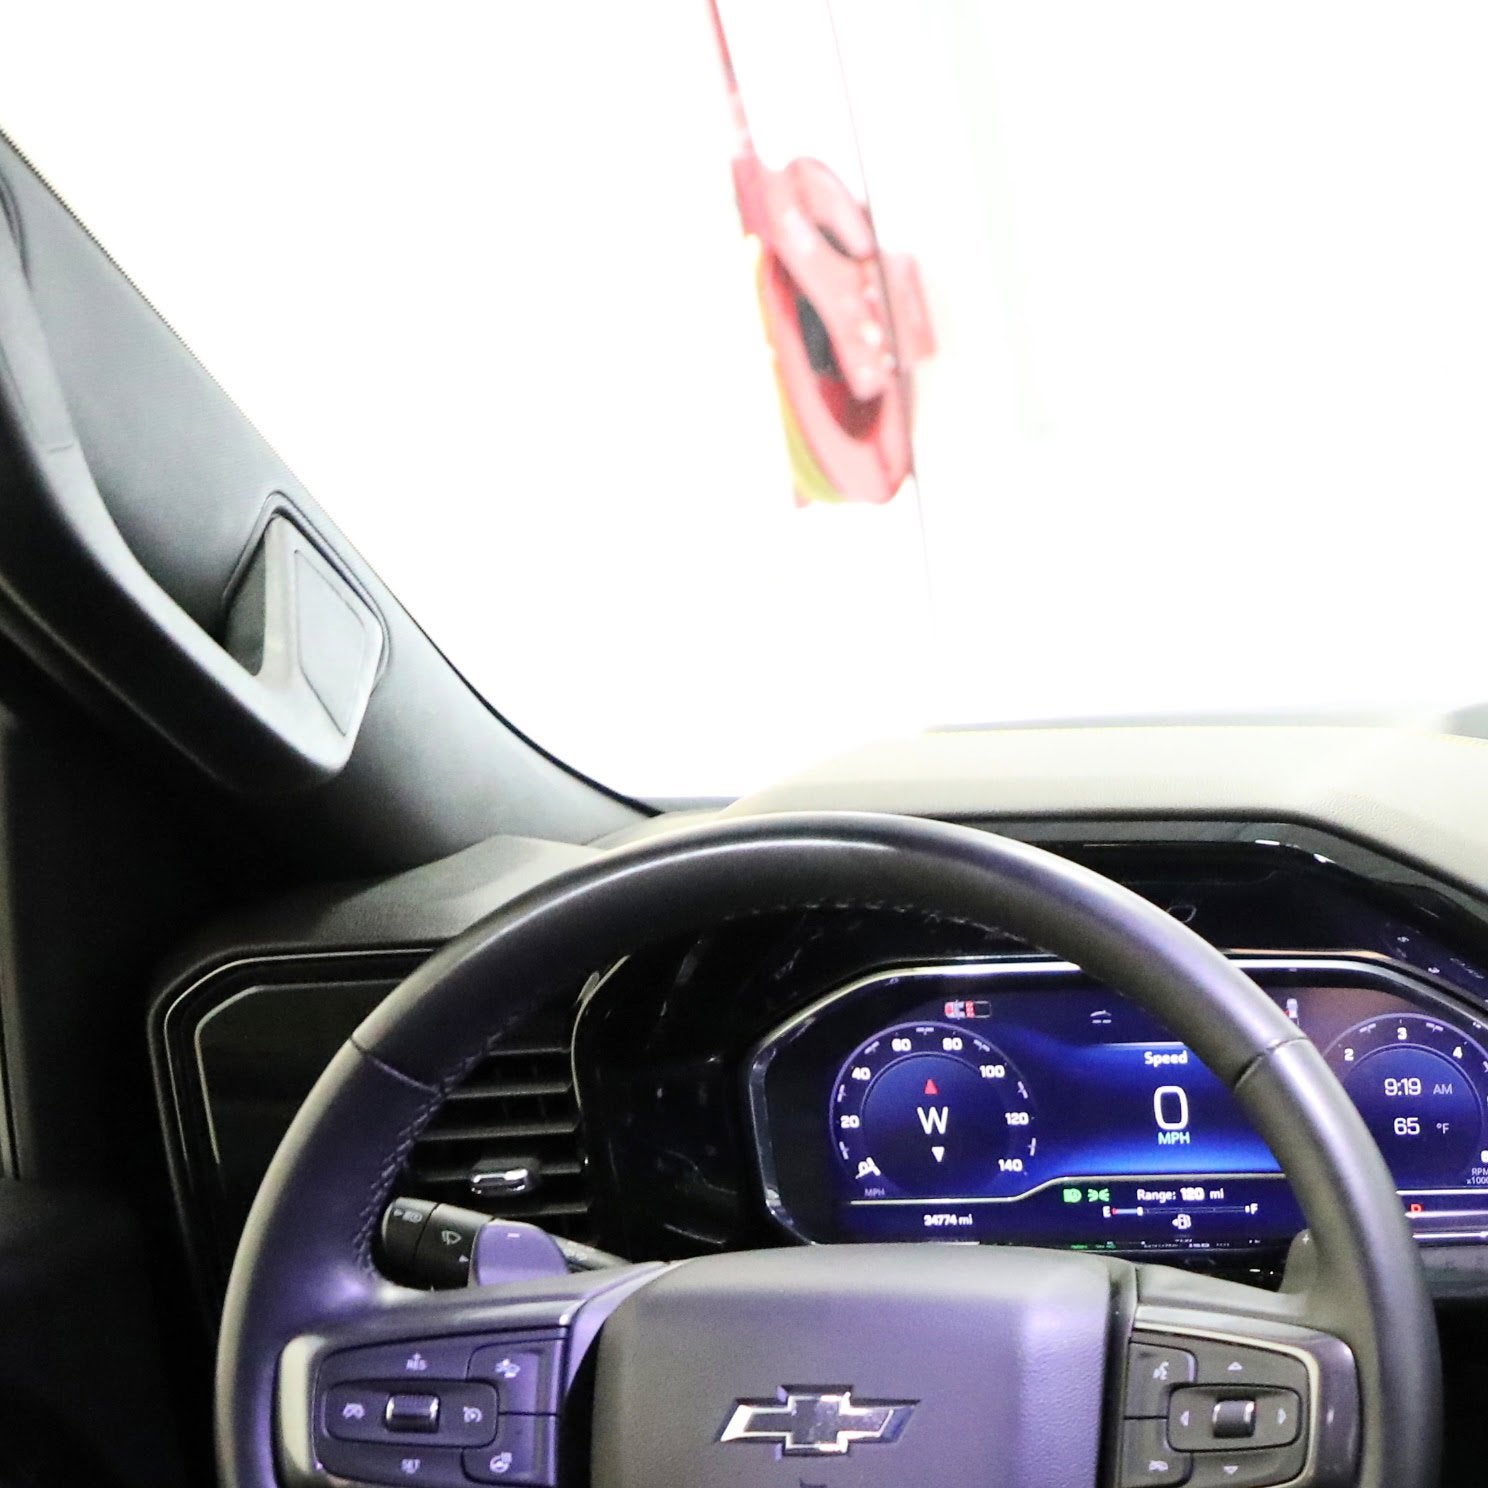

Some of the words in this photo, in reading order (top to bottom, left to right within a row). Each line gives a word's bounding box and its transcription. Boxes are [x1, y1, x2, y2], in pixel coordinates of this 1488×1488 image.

[1397, 1027, 1408, 1040] 3
[892, 1038, 912, 1051] 60
[942, 1038, 963, 1051] 80
[1144, 1051, 1188, 1067] Speed
[1344, 1048, 1354, 1061] 2
[1452, 1046, 1463, 1059] 4
[852, 1067, 871, 1080] 40
[979, 1065, 1005, 1078] 100
[1384, 1078, 1422, 1096] 9:19
[1433, 1083, 1453, 1095] AM
[1153, 1085, 1189, 1130] 0
[840, 1115, 860, 1128] 20
[917, 1106, 949, 1135] W
[1005, 1112, 1029, 1125] 120
[1393, 1117, 1420, 1135] 65
[1158, 1131, 1191, 1145] MPH
[998, 1159, 1024, 1172] 140
[864, 1187, 885, 1197] MPH
[1137, 1188, 1176, 1203] Range:
[1209, 1188, 1225, 1200] mi
[1102, 1206, 1111, 1218] E
[958, 1213, 973, 1226] mi
